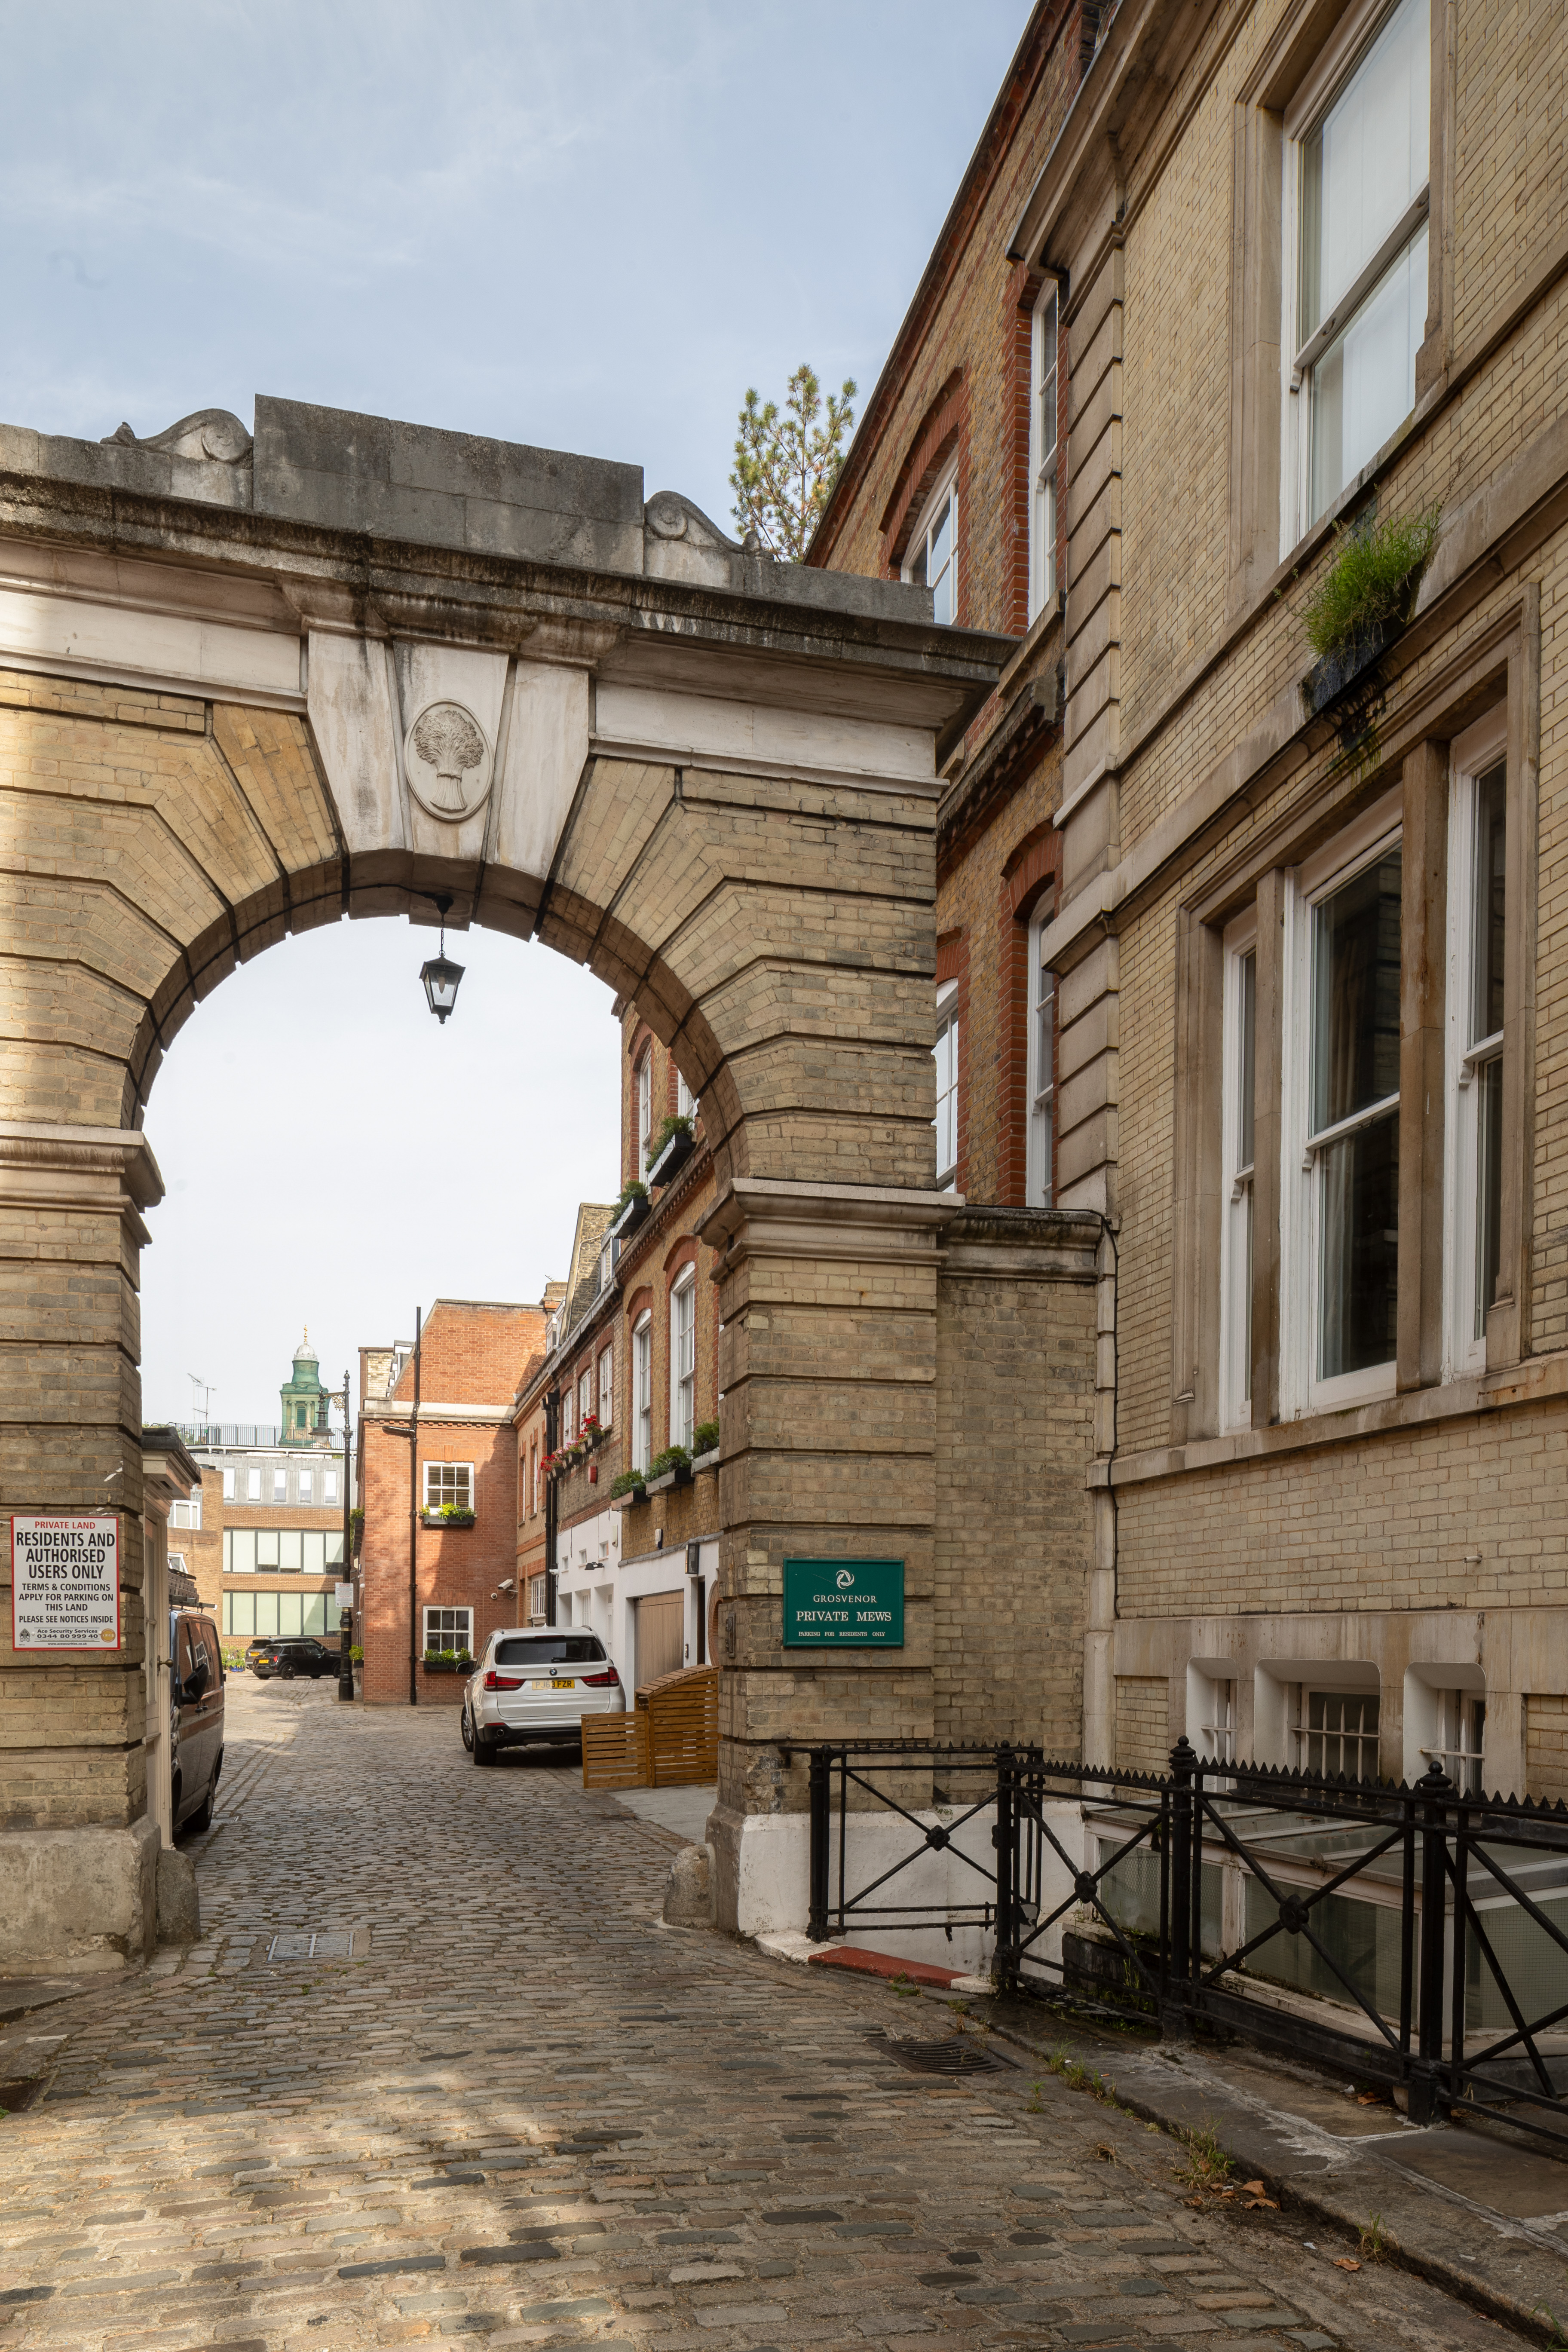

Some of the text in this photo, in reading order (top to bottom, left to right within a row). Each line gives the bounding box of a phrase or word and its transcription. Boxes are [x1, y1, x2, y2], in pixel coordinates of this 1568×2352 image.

[16, 1532, 115, 1547] RESIDENTS AND
[26, 1548, 105, 1563] AUTHORISED
[29, 1565, 104, 1579] USERS ONLY
[813, 1595, 877, 1603] GROSVENOR
[796, 1611, 891, 1621] PRIVATE MEWS
